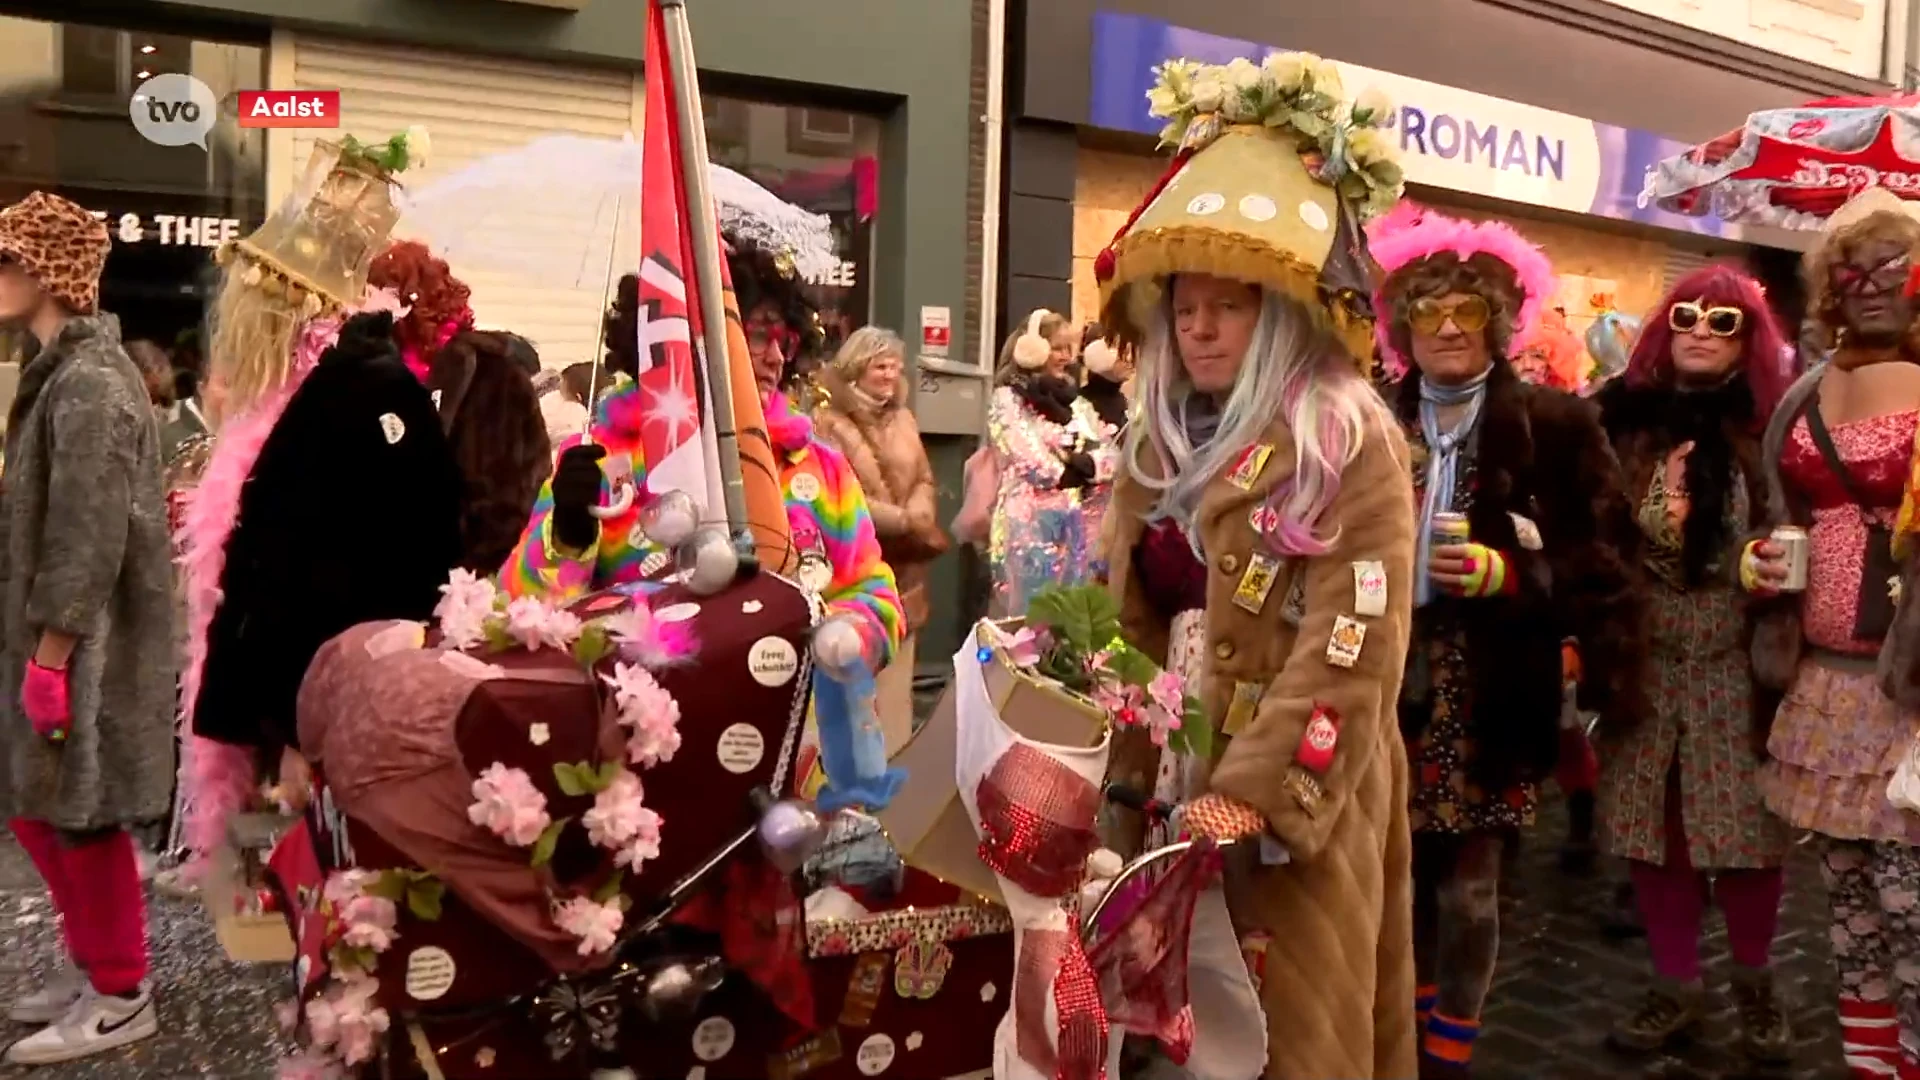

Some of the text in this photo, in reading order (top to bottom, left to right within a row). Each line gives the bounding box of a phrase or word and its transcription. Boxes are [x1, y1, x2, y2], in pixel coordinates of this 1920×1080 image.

[1376, 105, 1565, 182] ROMAN
[118, 212, 241, 247] & THEE
